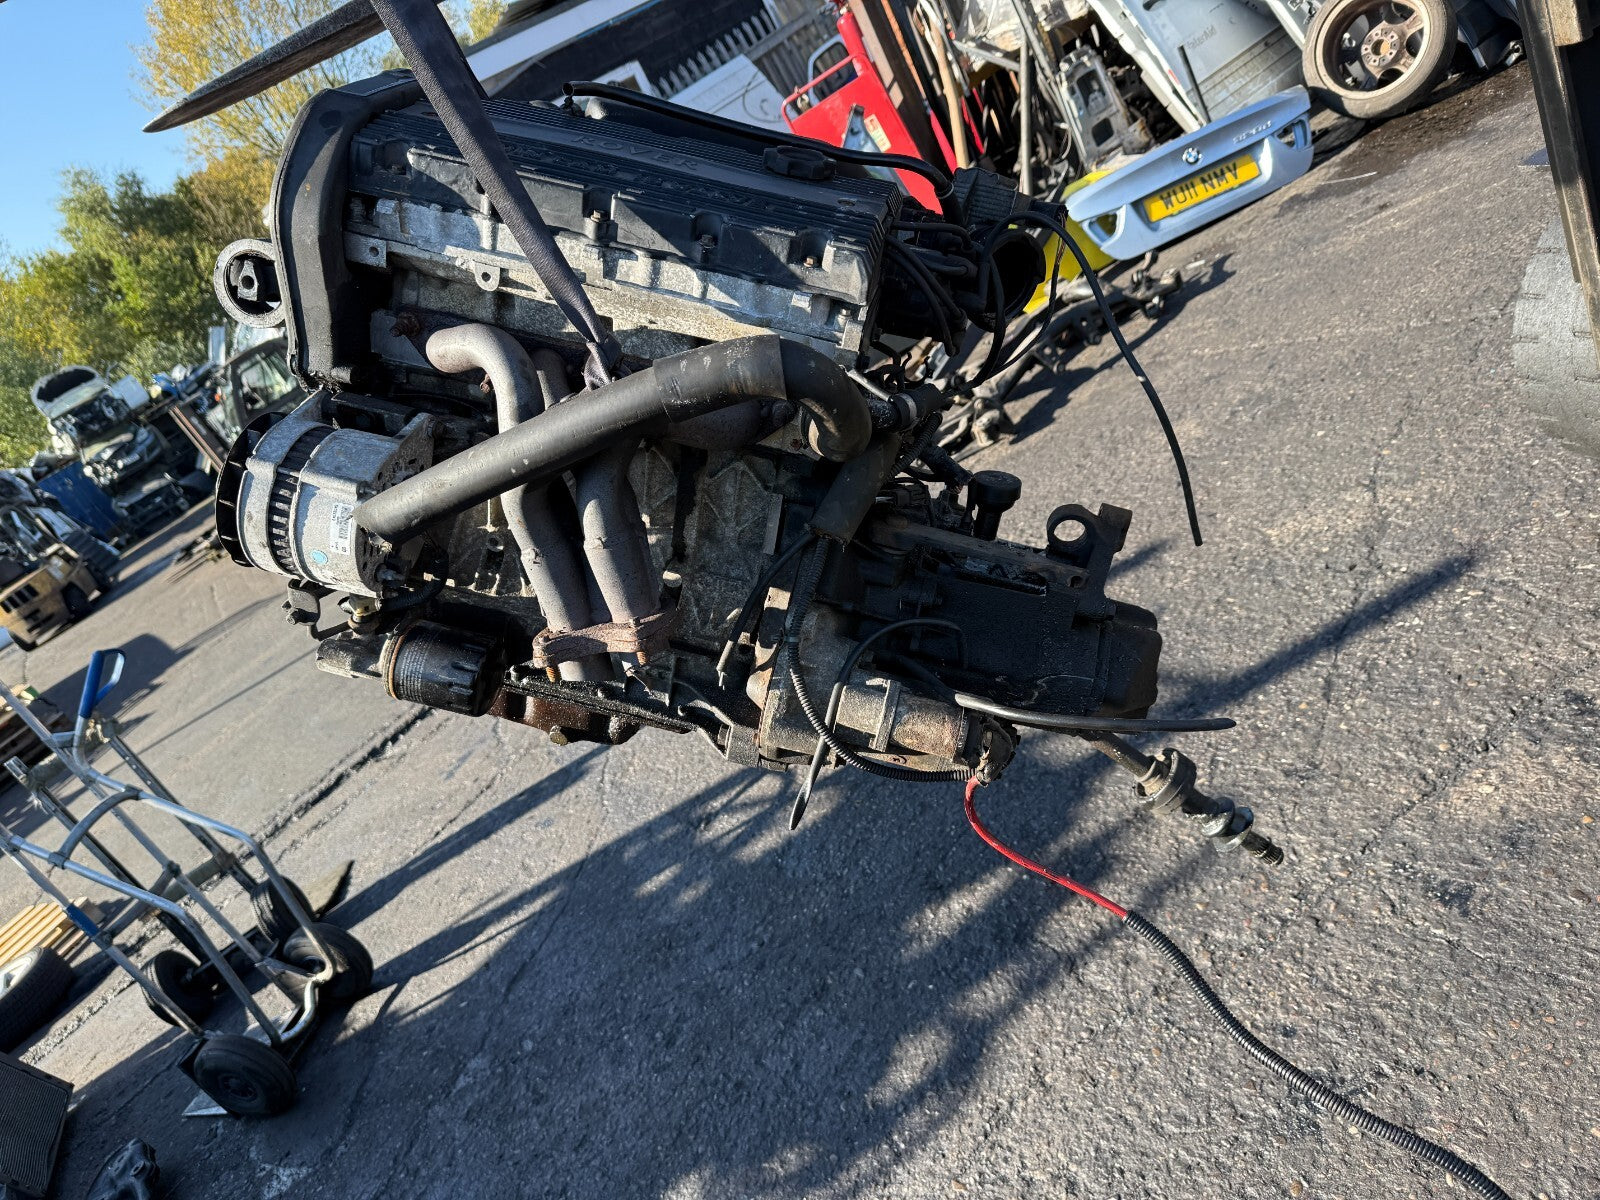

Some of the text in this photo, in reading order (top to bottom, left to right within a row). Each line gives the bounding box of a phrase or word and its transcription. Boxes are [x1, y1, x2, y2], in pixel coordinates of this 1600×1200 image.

[572, 136, 698, 170] ROVER
[1160, 162, 1238, 209] WU11 NMV
